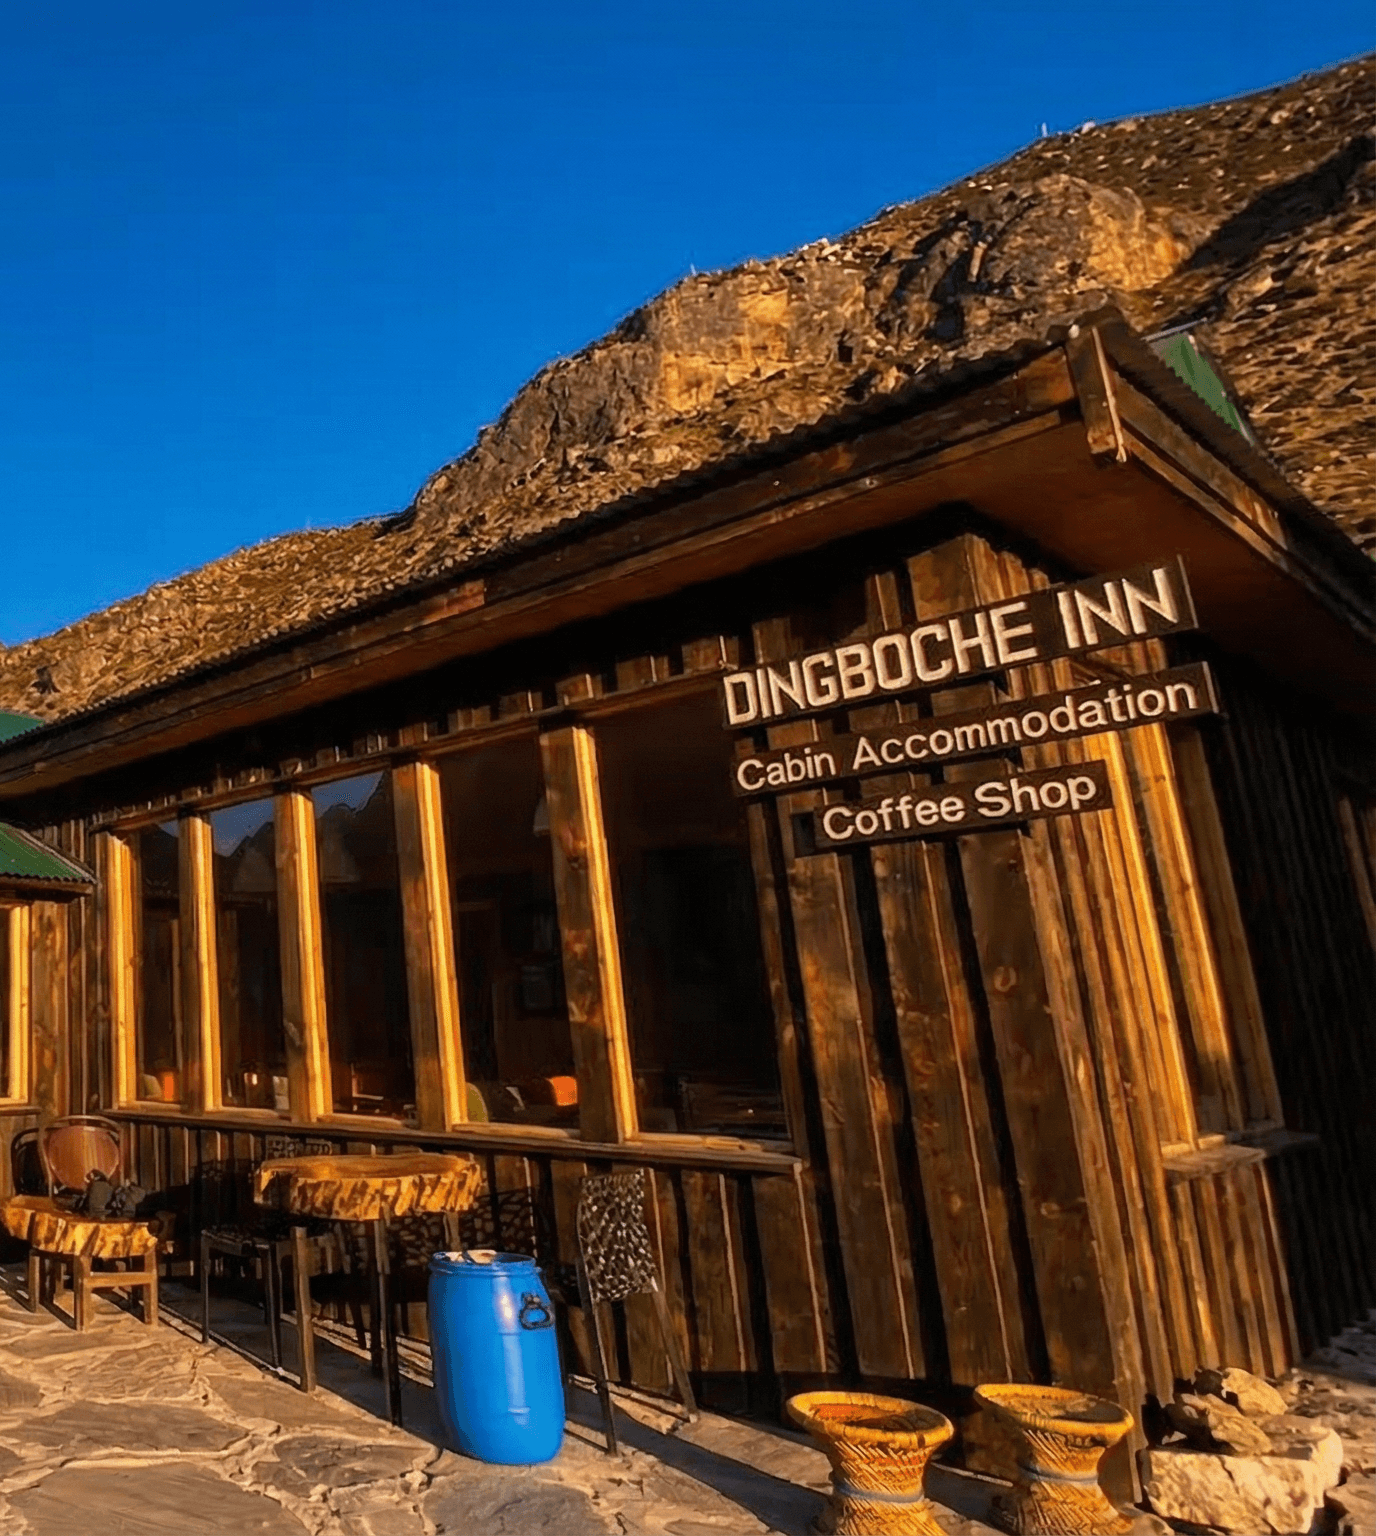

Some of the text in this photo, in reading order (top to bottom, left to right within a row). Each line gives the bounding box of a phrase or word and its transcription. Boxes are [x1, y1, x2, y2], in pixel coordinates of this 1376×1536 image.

[724, 568, 1179, 725] DINGBOCHE INN
[736, 679, 1198, 791] Cabin Accommodation
[822, 773, 1097, 841] Coffee Shop
